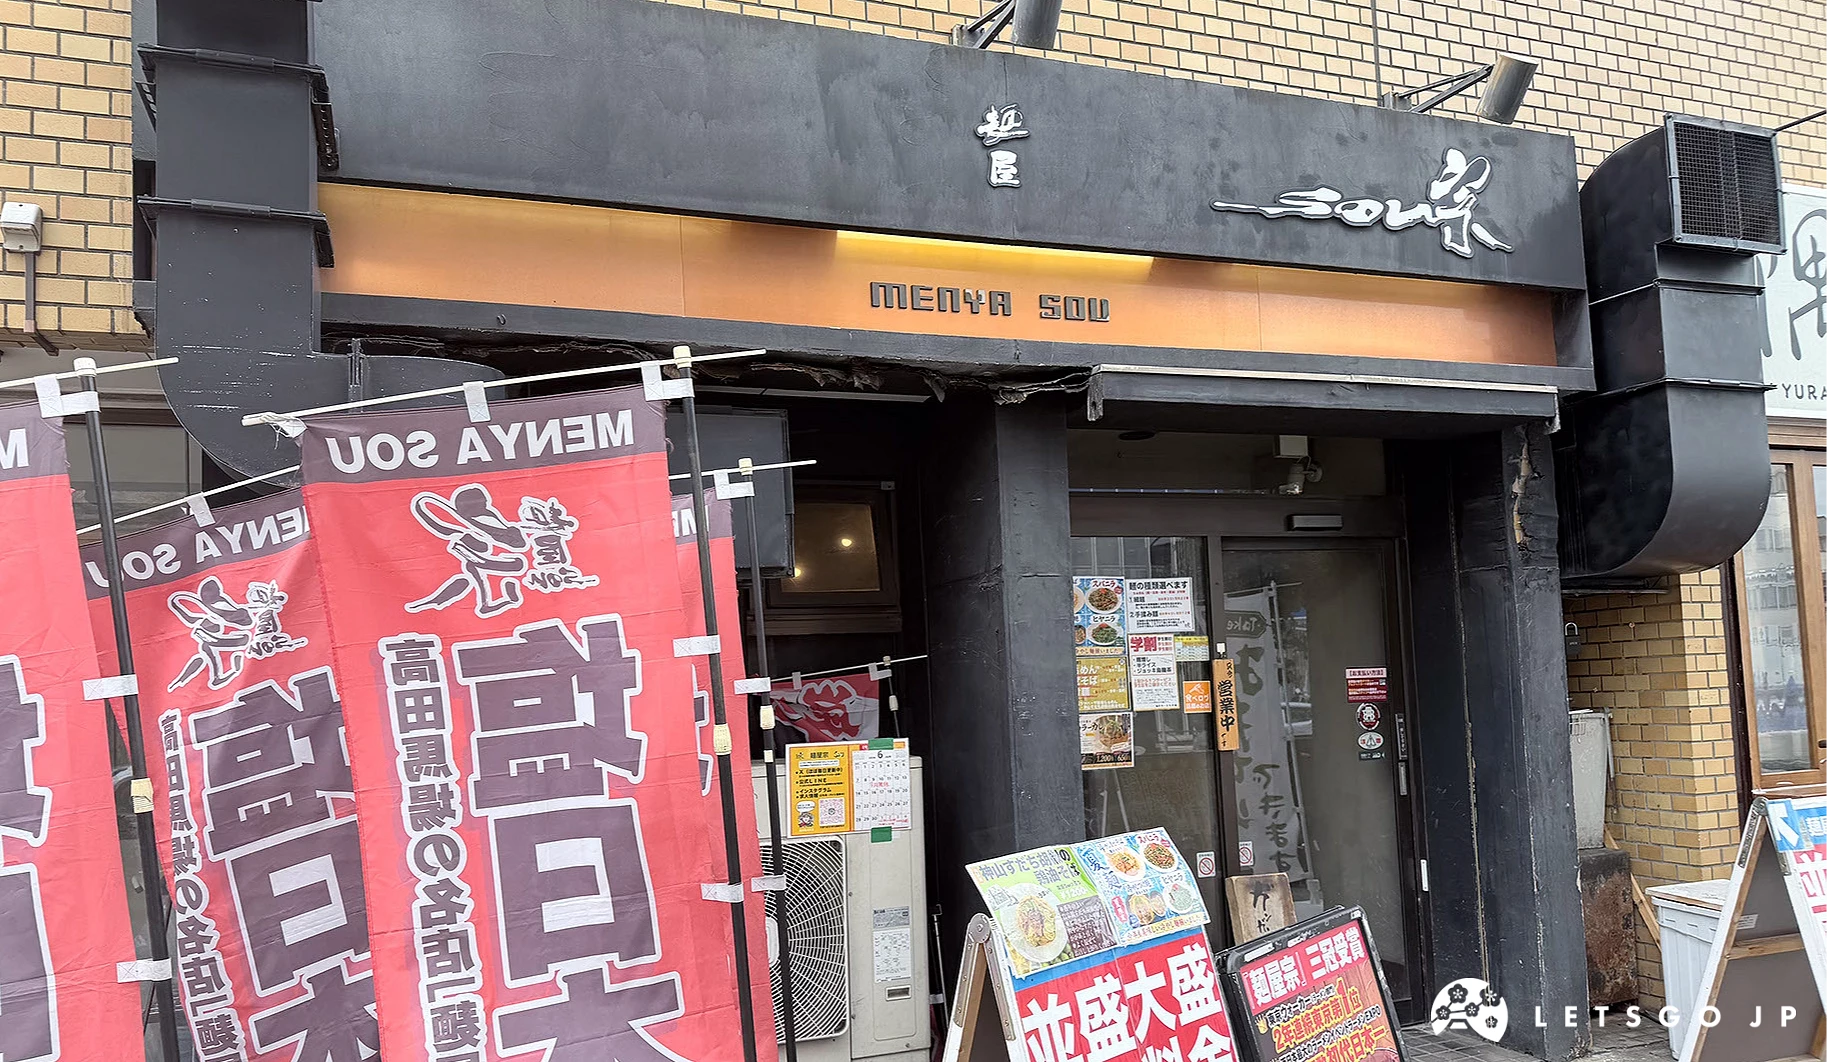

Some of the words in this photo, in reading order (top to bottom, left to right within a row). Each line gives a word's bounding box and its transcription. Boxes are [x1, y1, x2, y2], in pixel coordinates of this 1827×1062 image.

[870, 281, 1013, 318] MENYA
[1040, 294, 1110, 324] SOU
[1131, 636, 1157, 652] 学割
[877, 750, 883, 759] 6
